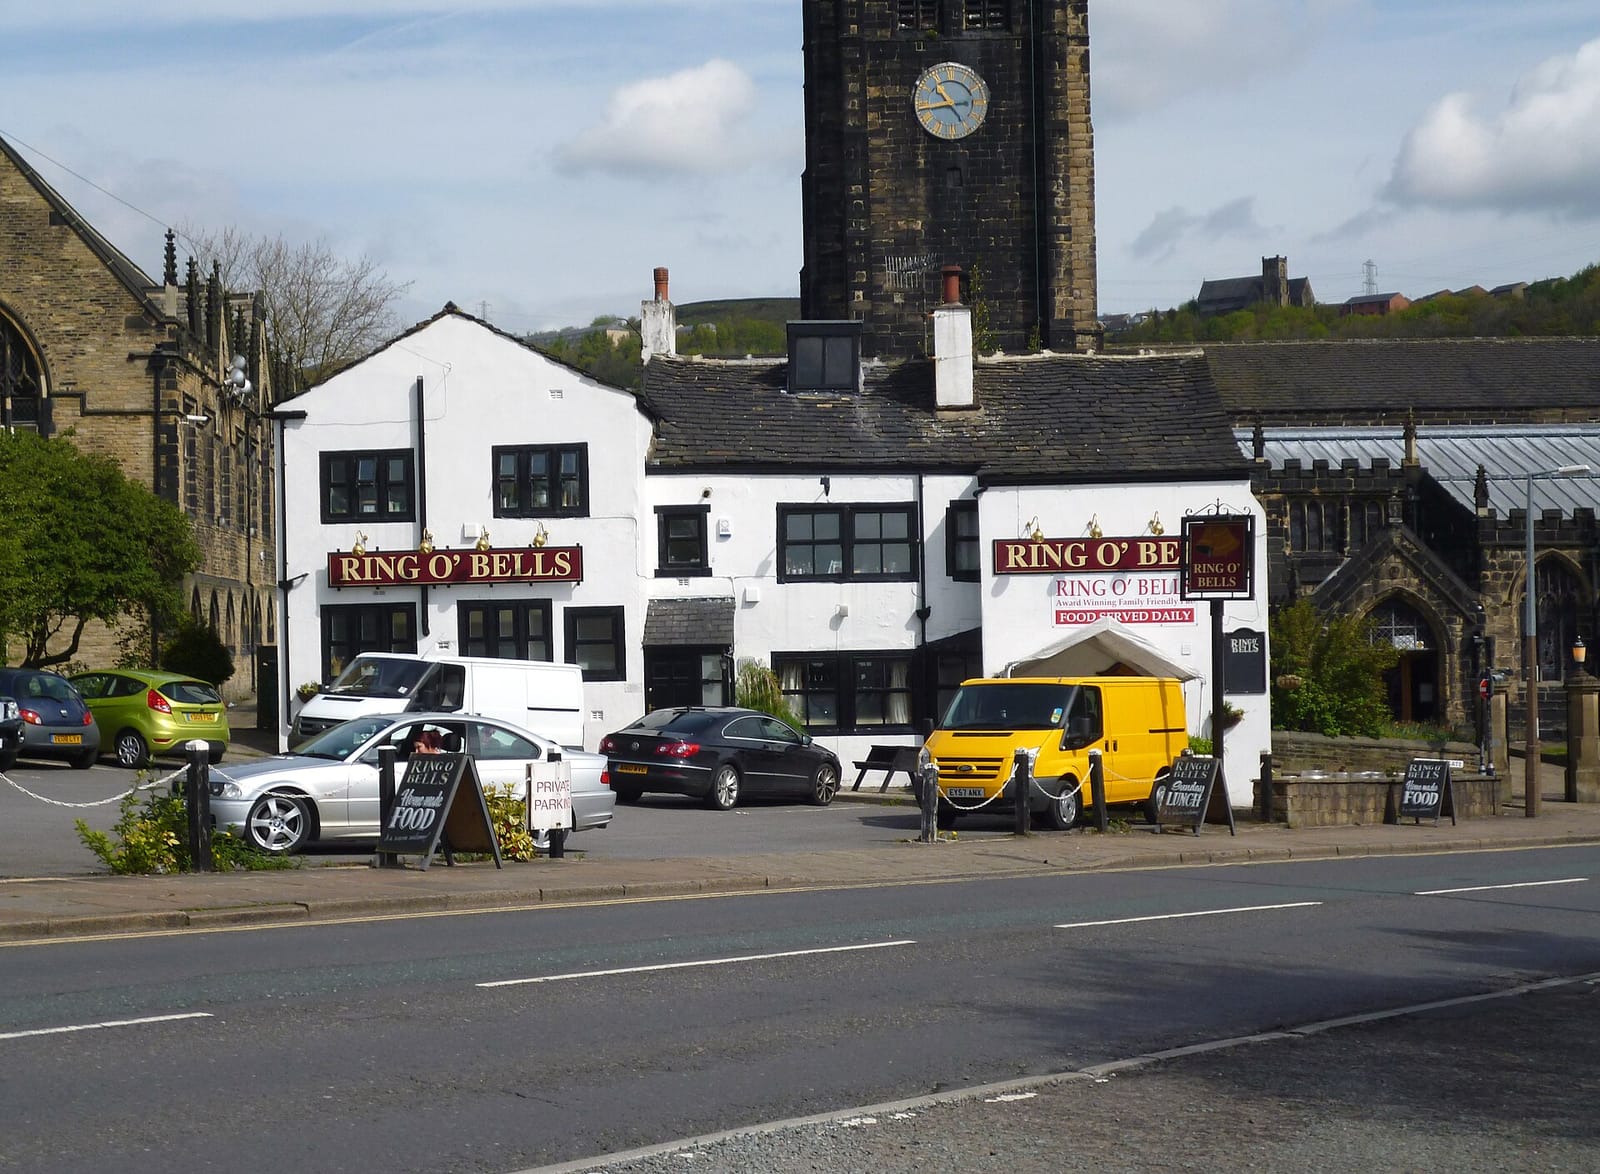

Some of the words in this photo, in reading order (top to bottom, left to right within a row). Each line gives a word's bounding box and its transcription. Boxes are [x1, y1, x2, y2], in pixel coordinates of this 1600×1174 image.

[1005, 543, 1088, 568] RING
[1096, 542, 1128, 567] O'
[339, 556, 421, 581] RING
[428, 554, 462, 579] O'
[470, 551, 572, 577] BELLS
[1193, 564, 1224, 574] RING
[1056, 579, 1106, 597] RING
[1112, 578, 1132, 595] O'
[1138, 578, 1192, 595] BELL
[1198, 577, 1236, 587] BELLS
[1056, 599, 1081, 607] Award
[1083, 599, 1117, 608] Winning
[1118, 598, 1144, 608] Family
[1146, 596, 1179, 607] Friendly
[1060, 612, 1096, 622] FOOD
[1152, 611, 1191, 621] DAILY
[1232, 644, 1259, 653] BELLS
[411, 760, 443, 774] RING
[1176, 762, 1201, 771] RING
[407, 773, 450, 785] BELLS
[1174, 770, 1208, 779] BELLS
[1408, 771, 1439, 779] BELLS
[1171, 781, 1205, 793] Sunday
[1166, 792, 1203, 807] LUNCH
[1403, 791, 1439, 805] FOOD
[388, 806, 436, 831] FOOD
